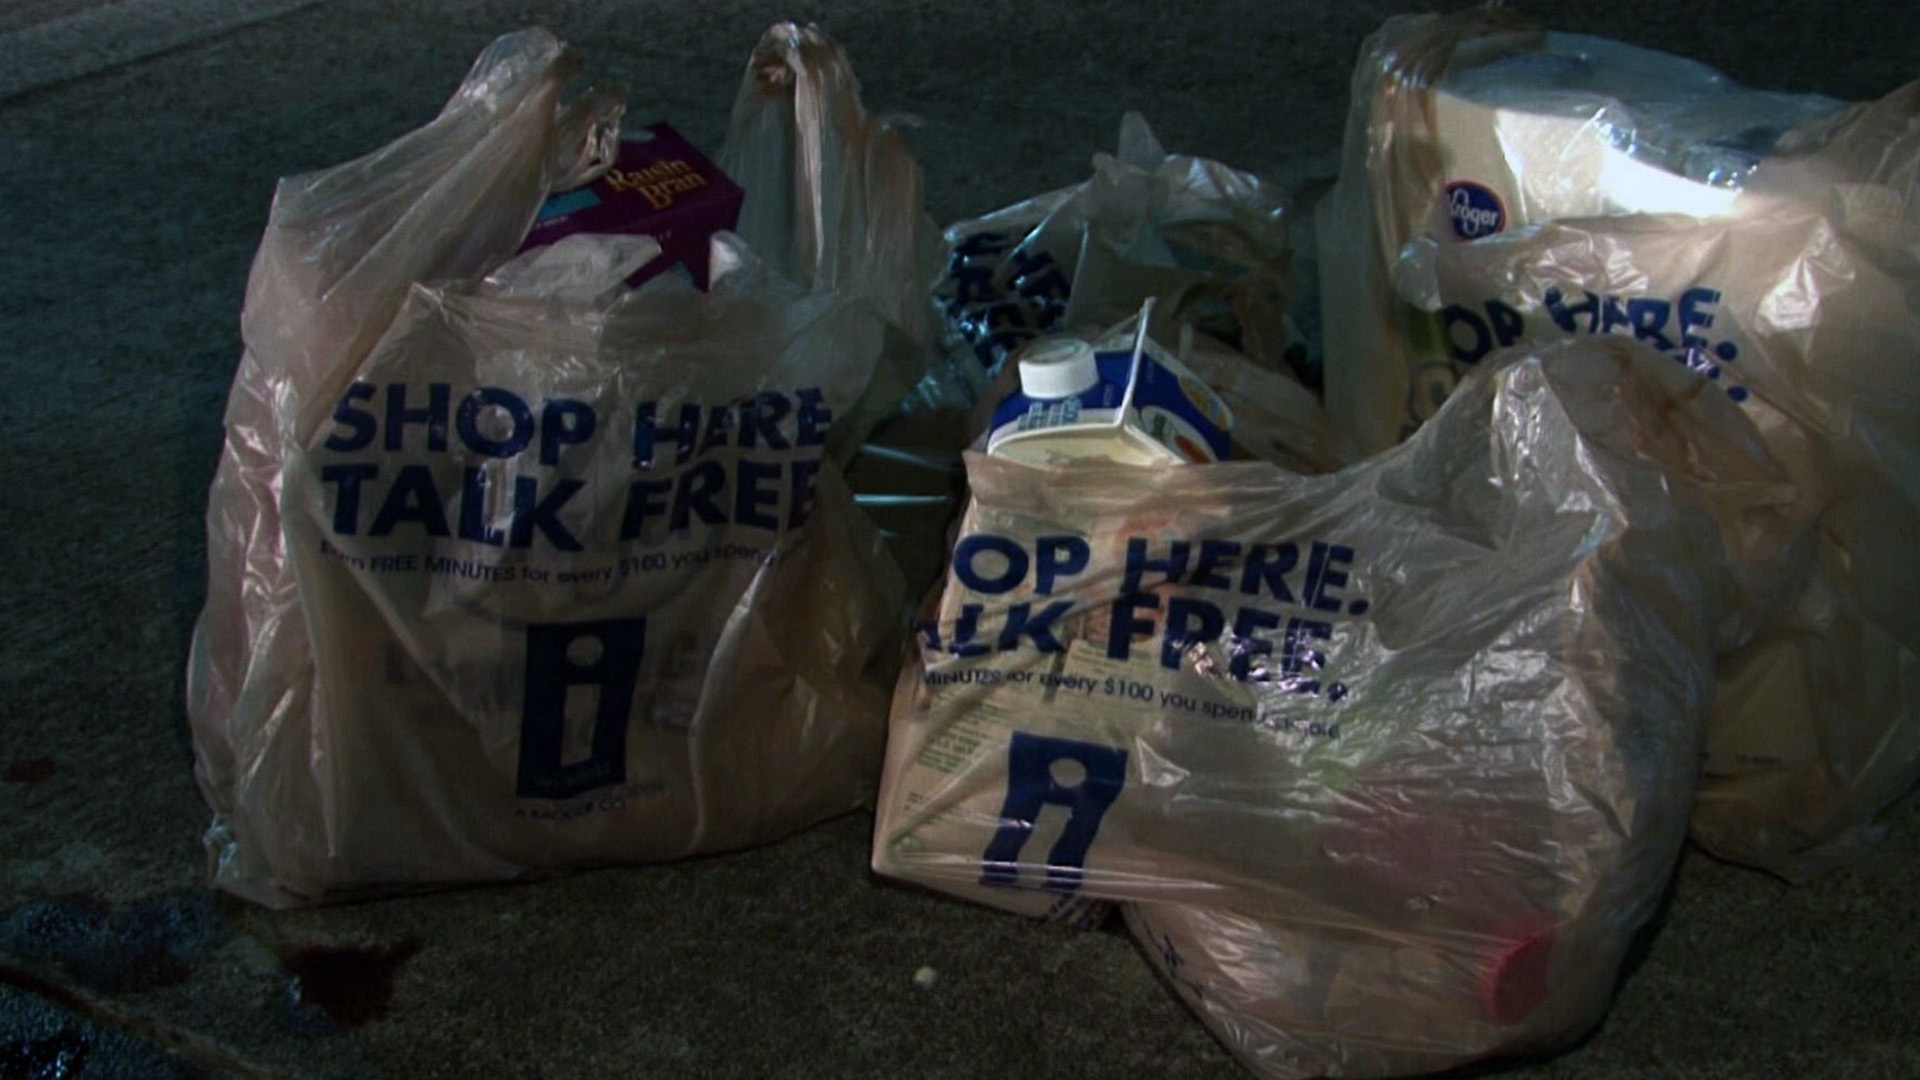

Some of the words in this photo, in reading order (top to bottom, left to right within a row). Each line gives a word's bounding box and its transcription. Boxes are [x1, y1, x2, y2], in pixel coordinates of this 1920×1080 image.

[325, 382, 595, 467] SHOP
[322, 464, 587, 551] TALK
[371, 554, 417, 573] FREE
[425, 556, 514, 582] MINUTES
[522, 565, 549, 582] for
[620, 552, 666, 578] $100
[672, 550, 708, 569] you
[1103, 680, 1153, 702] $100
[1160, 690, 1196, 711] you
